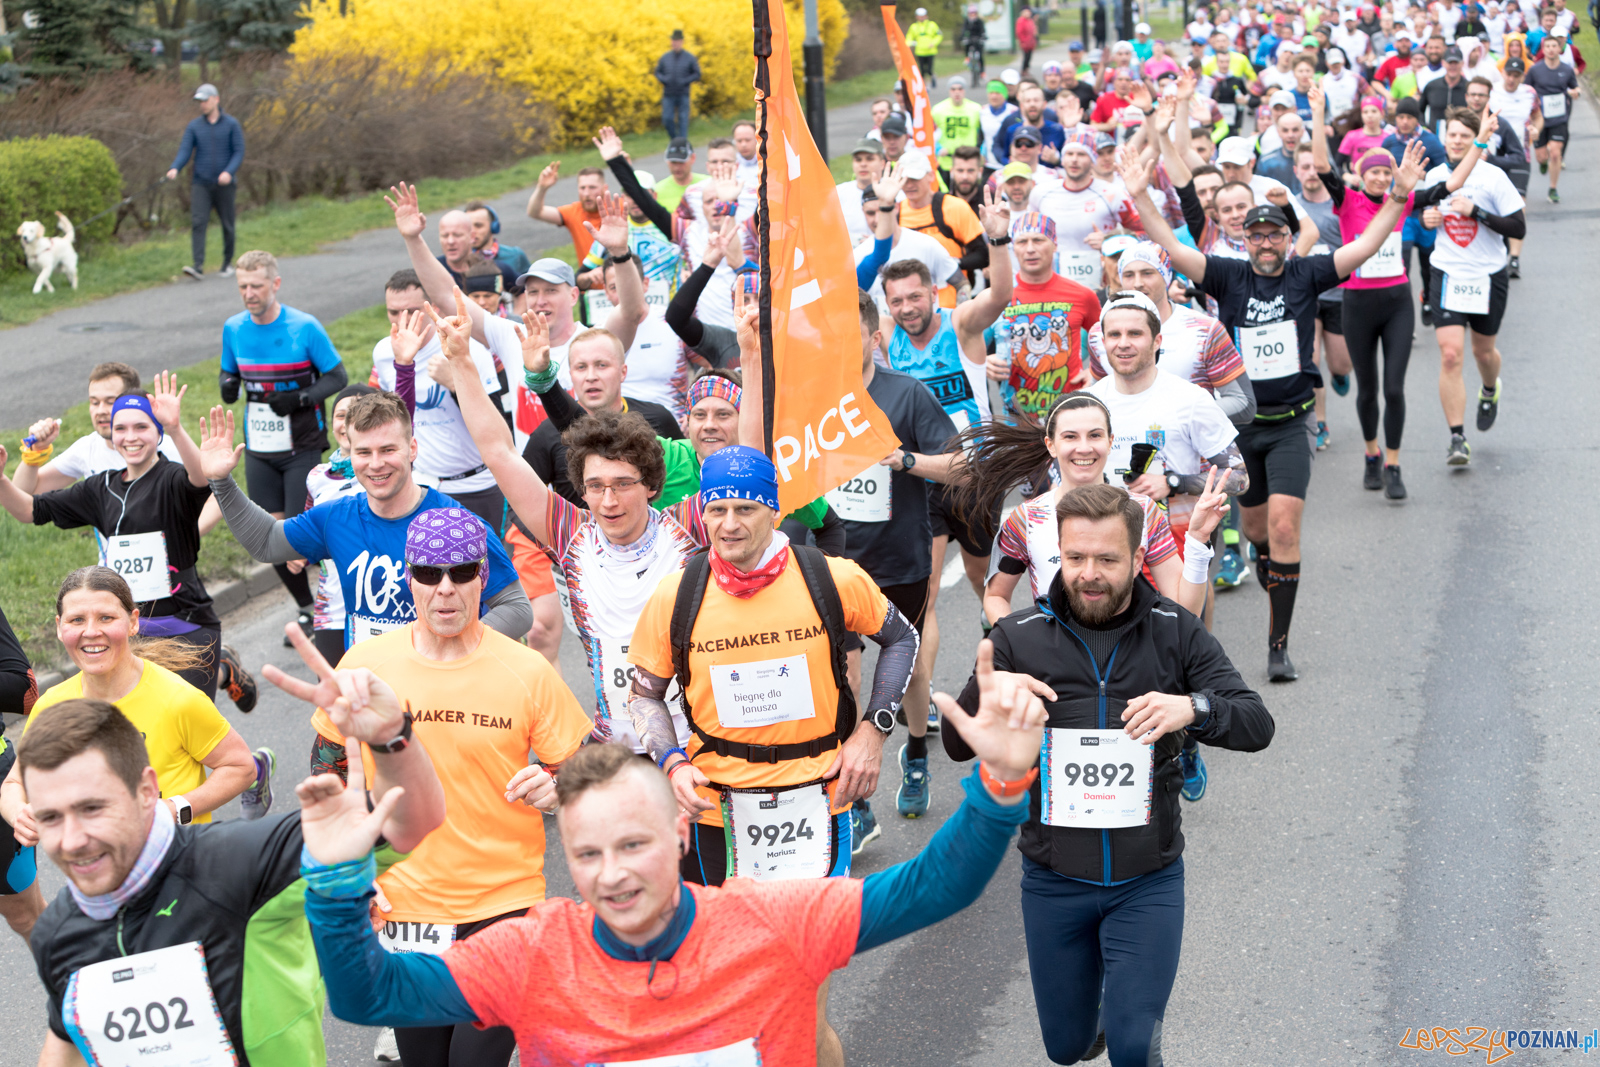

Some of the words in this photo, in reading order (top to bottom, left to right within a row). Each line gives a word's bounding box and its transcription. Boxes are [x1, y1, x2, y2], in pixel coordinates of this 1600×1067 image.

[1067, 265, 1093, 275] 1150
[1454, 285, 1481, 295] 8934
[1253, 342, 1284, 358] 700
[1038, 365, 1068, 394] NO
[251, 420, 285, 431] 10288
[774, 392, 871, 483] PACE
[114, 556, 153, 574] 9287
[689, 632, 781, 653] PACEMAKER
[785, 625, 826, 642] TEAM
[734, 692, 764, 703] biegnę
[767, 689, 781, 699] dla
[742, 703, 777, 715] Janusza
[472, 713, 512, 730] TEAM
[1064, 763, 1134, 787] 9892
[747, 818, 814, 846] 9924
[767, 849, 796, 858] Mariusz
[104, 997, 194, 1042] 6202
